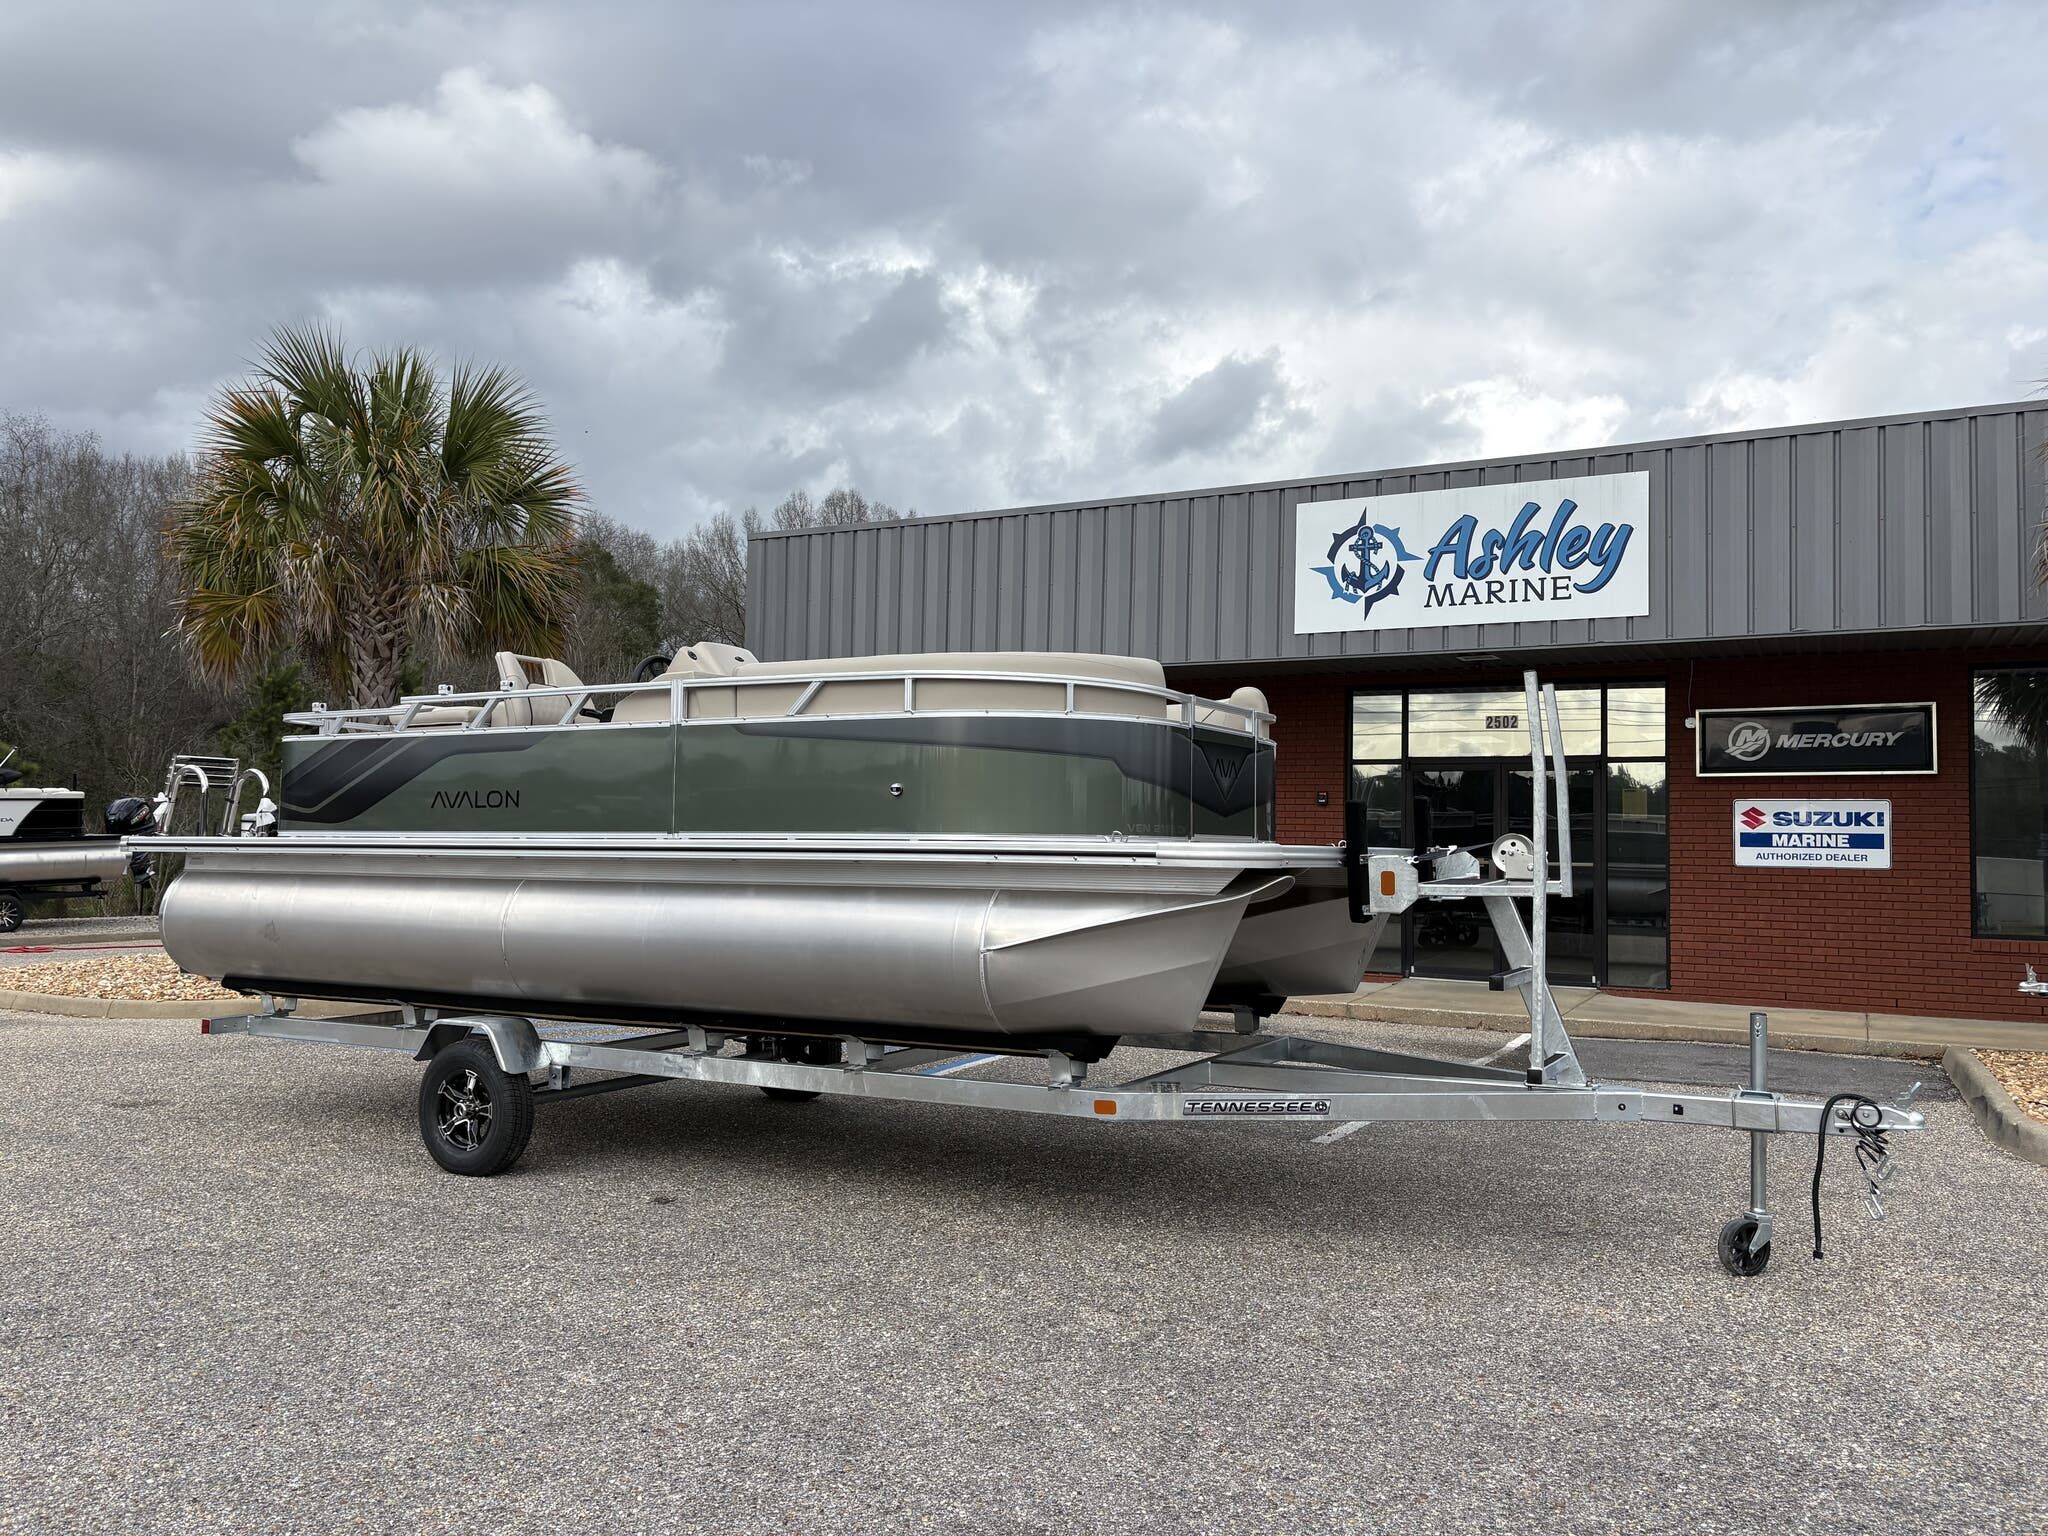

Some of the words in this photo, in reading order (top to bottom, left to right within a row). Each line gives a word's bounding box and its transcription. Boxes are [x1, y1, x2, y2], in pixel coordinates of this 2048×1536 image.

[1423, 498, 1634, 594] Ashley
[1423, 575, 1573, 608] MARINE
[1486, 715, 1518, 729] 2502
[1775, 731, 1904, 749] MERCURY
[430, 790, 520, 808] AVALON
[1772, 811, 1885, 827] SUZUKI
[1772, 833, 1850, 848] MARINE
[1755, 852, 1823, 862] AUTHORIZED
[1825, 852, 1868, 862] DEALER
[1186, 1102, 1313, 1113] TENNESSEE
